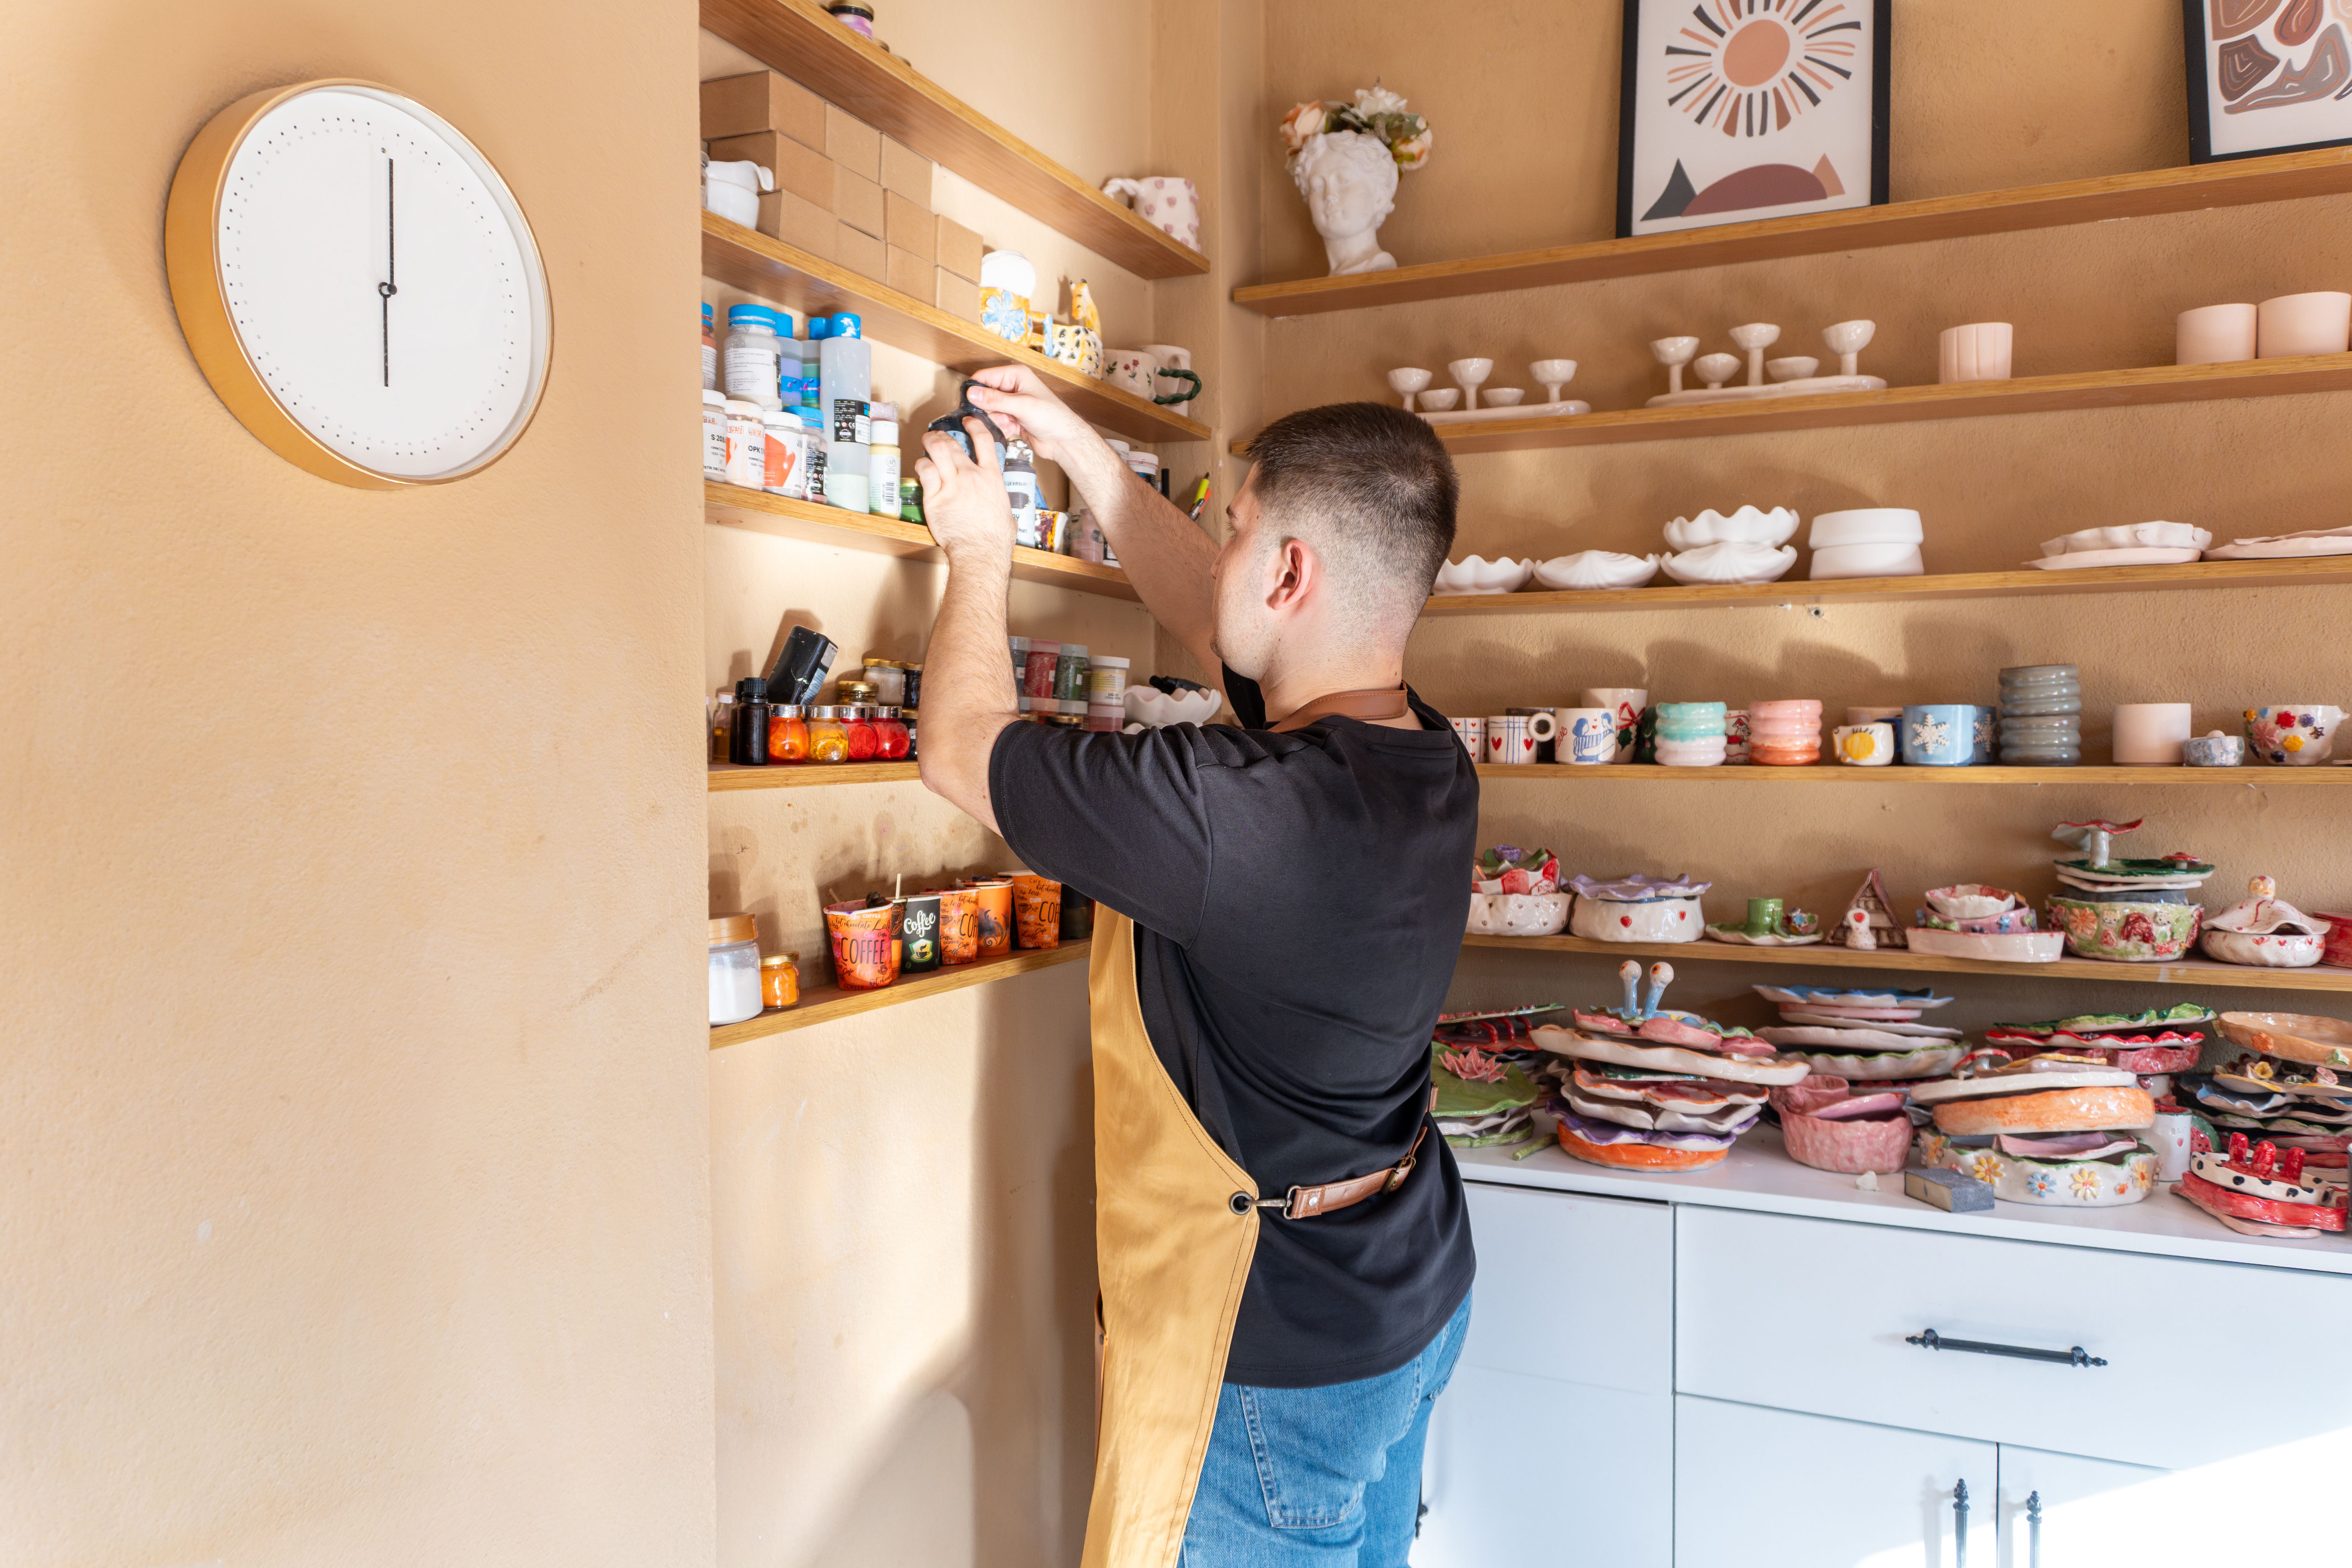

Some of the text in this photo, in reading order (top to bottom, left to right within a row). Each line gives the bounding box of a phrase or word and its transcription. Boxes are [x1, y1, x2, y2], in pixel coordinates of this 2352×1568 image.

[748, 445, 760, 453] OPK
[836, 917, 846, 927] hot
[844, 920, 873, 930] chocolate
[903, 910, 936, 937] Coffee
[841, 937, 885, 965] COFFEE
[842, 967, 854, 976] Cafe
